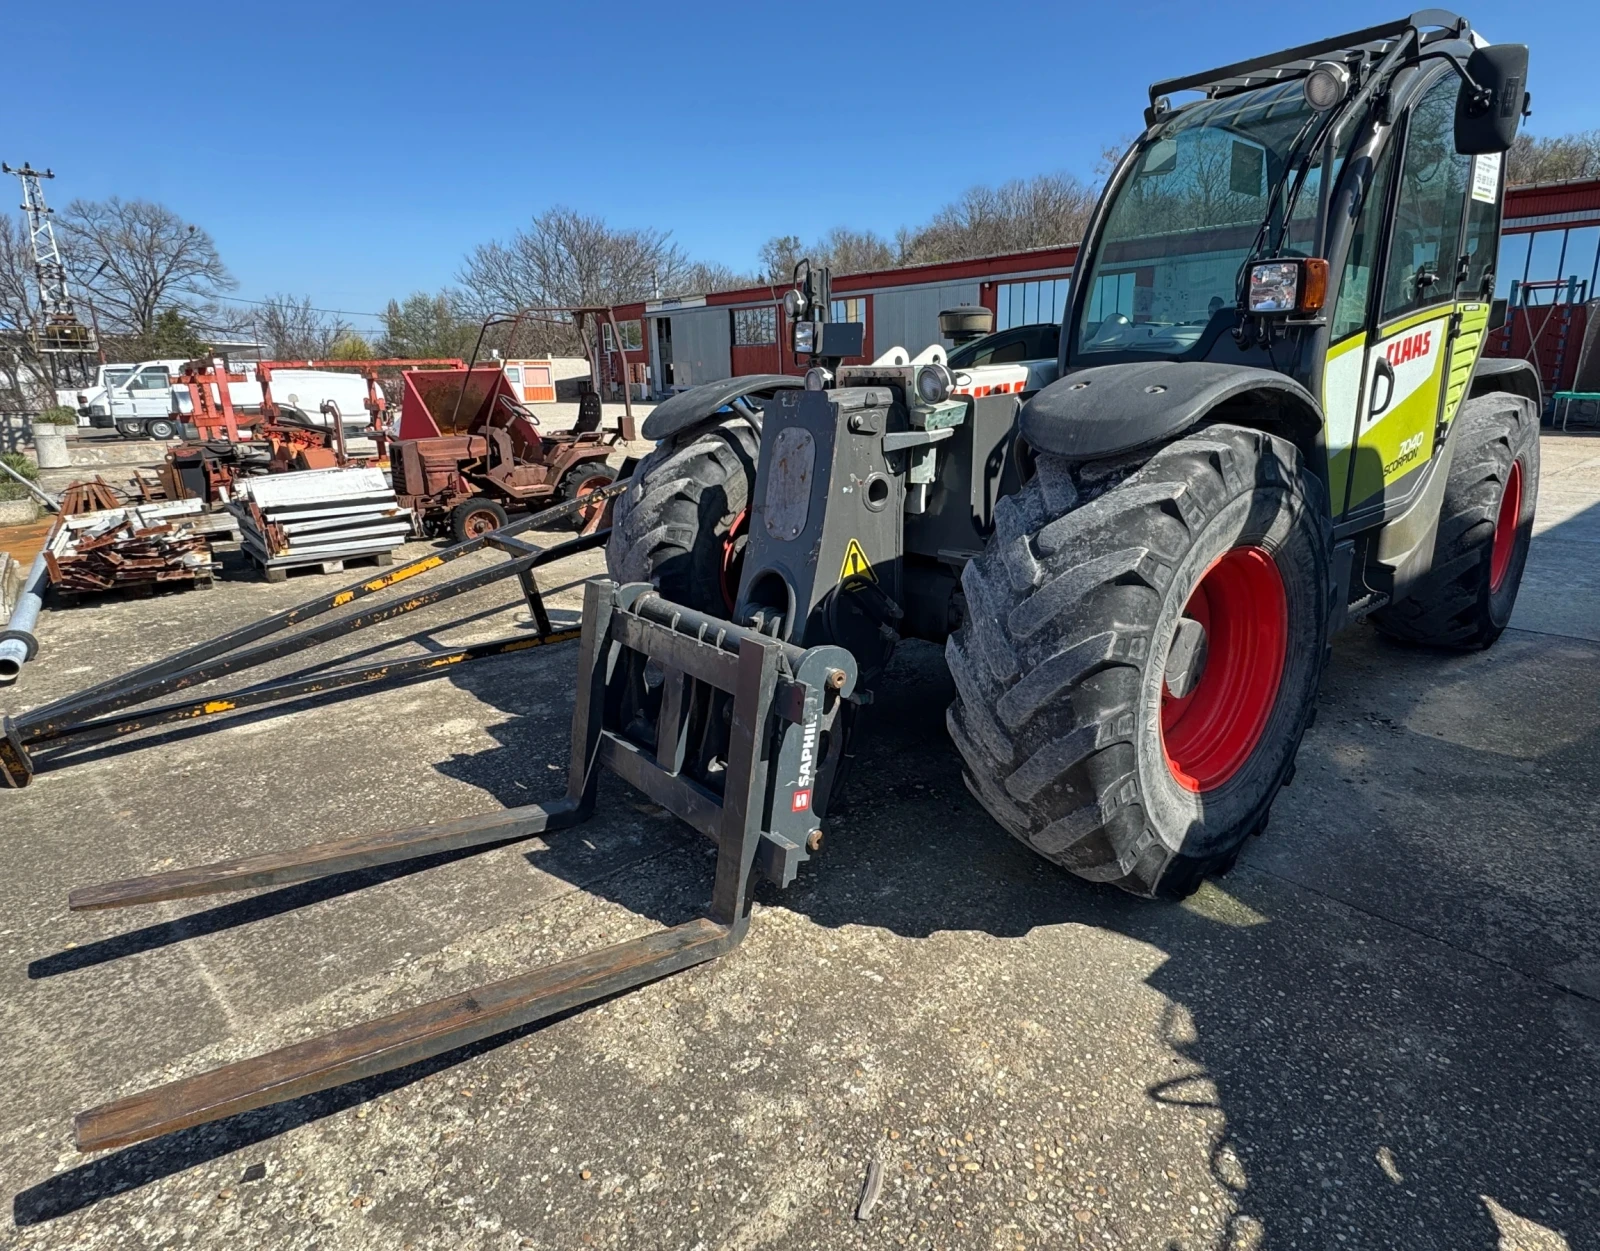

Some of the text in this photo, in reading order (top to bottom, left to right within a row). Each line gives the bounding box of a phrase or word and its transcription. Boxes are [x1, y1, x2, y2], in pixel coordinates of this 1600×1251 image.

[1386, 330, 1431, 367] CLAAS
[1398, 431, 1424, 458] 7040
[1383, 446, 1419, 477] SCORPION
